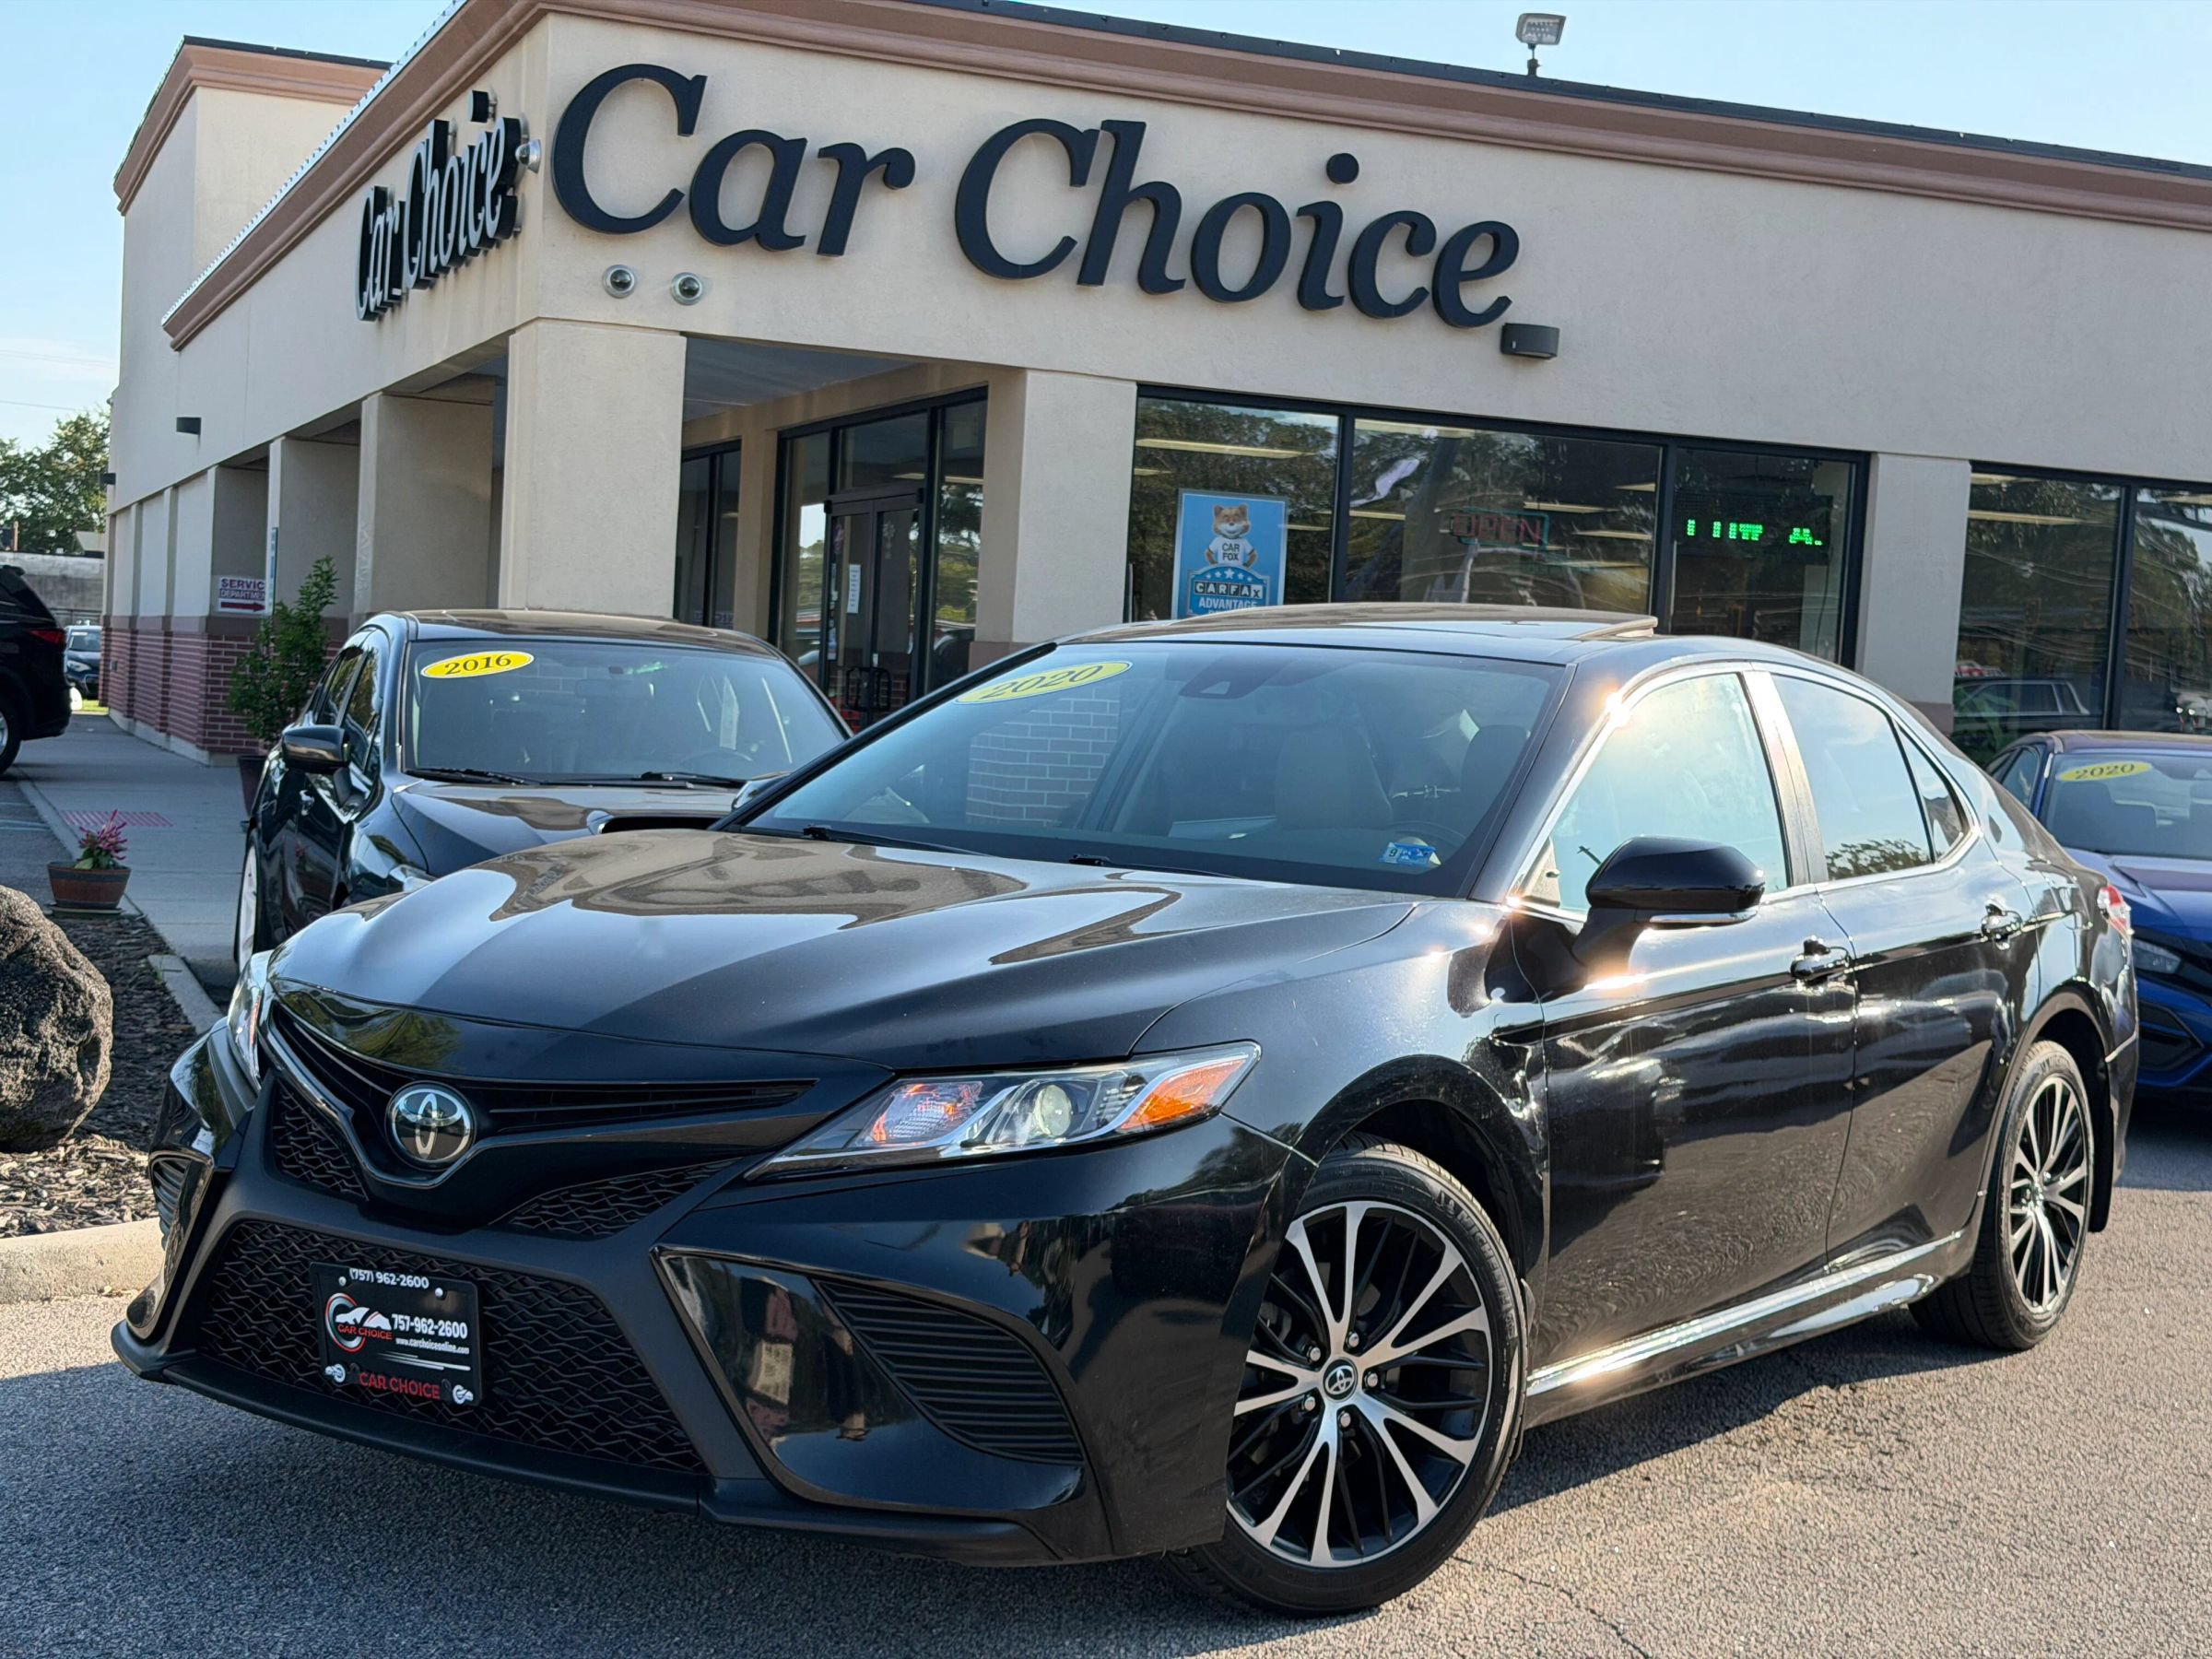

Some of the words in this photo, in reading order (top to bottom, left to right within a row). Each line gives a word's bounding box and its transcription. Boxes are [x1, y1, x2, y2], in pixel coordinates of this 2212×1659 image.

[356, 185, 404, 321] Car
[404, 90, 521, 289] Choice
[551, 64, 916, 256] Car
[955, 118, 1520, 328] Choice
[1453, 513, 1542, 546] OPEN
[1222, 543, 1240, 552] CAR
[1222, 553, 1239, 561] FOX
[220, 589, 265, 600] DEPARTME
[221, 578, 265, 590] SERVIC
[1195, 582, 1262, 599] CARFAX
[444, 653, 512, 676] 2016
[979, 665, 1103, 700] 2020
[2075, 763, 2135, 780] 2020
[1456, 1209, 1513, 1313] MICHELIN
[349, 1268, 375, 1283] (757)
[375, 1272, 429, 1289] 962-2600
[337, 1324, 358, 1335] CAR
[358, 1327, 394, 1340] CHOICE
[391, 1313, 468, 1339] 757-962-2600
[359, 1371, 388, 1391] CAR
[389, 1377, 441, 1399] CHOICE
